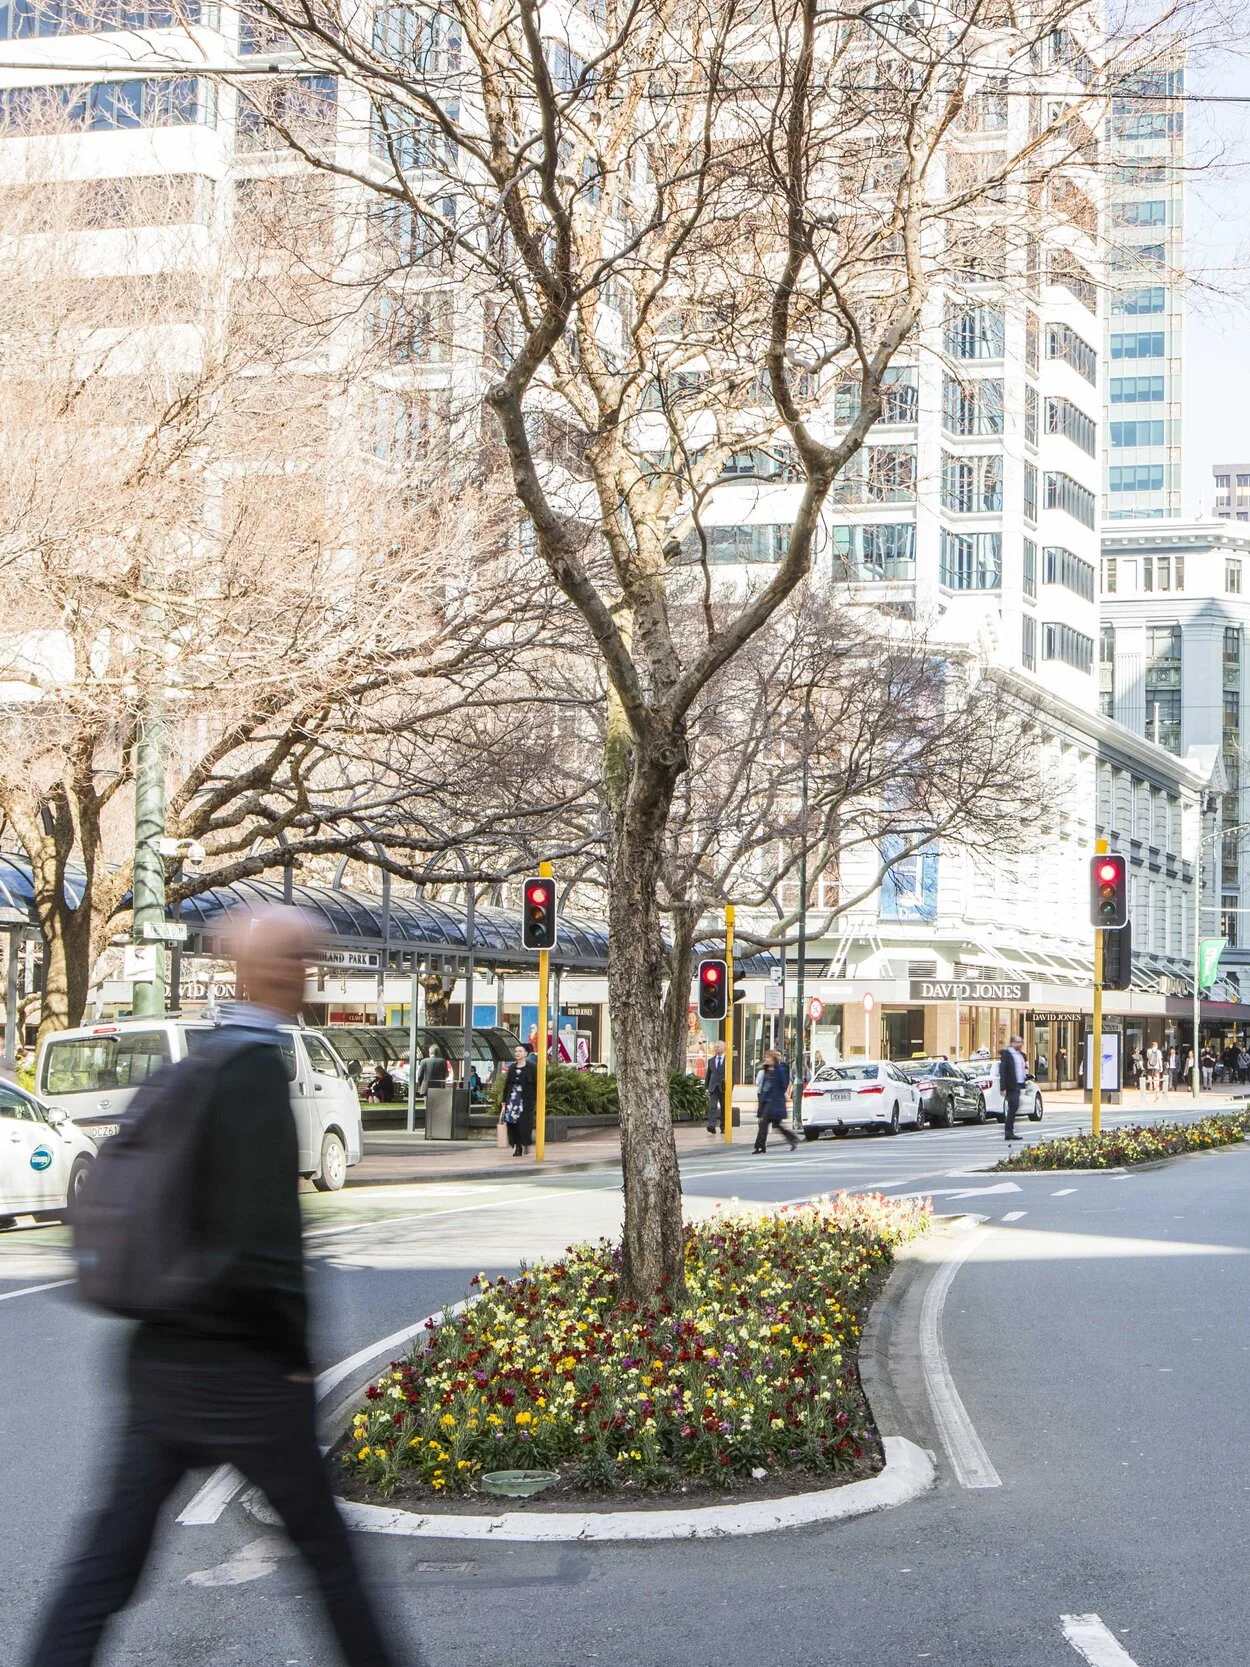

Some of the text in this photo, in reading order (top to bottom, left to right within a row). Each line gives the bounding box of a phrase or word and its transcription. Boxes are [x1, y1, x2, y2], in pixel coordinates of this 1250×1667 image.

[319, 951, 367, 965] DLAND PARK
[164, 982, 205, 997] DVID
[921, 983, 1021, 998] DAVID JONES
